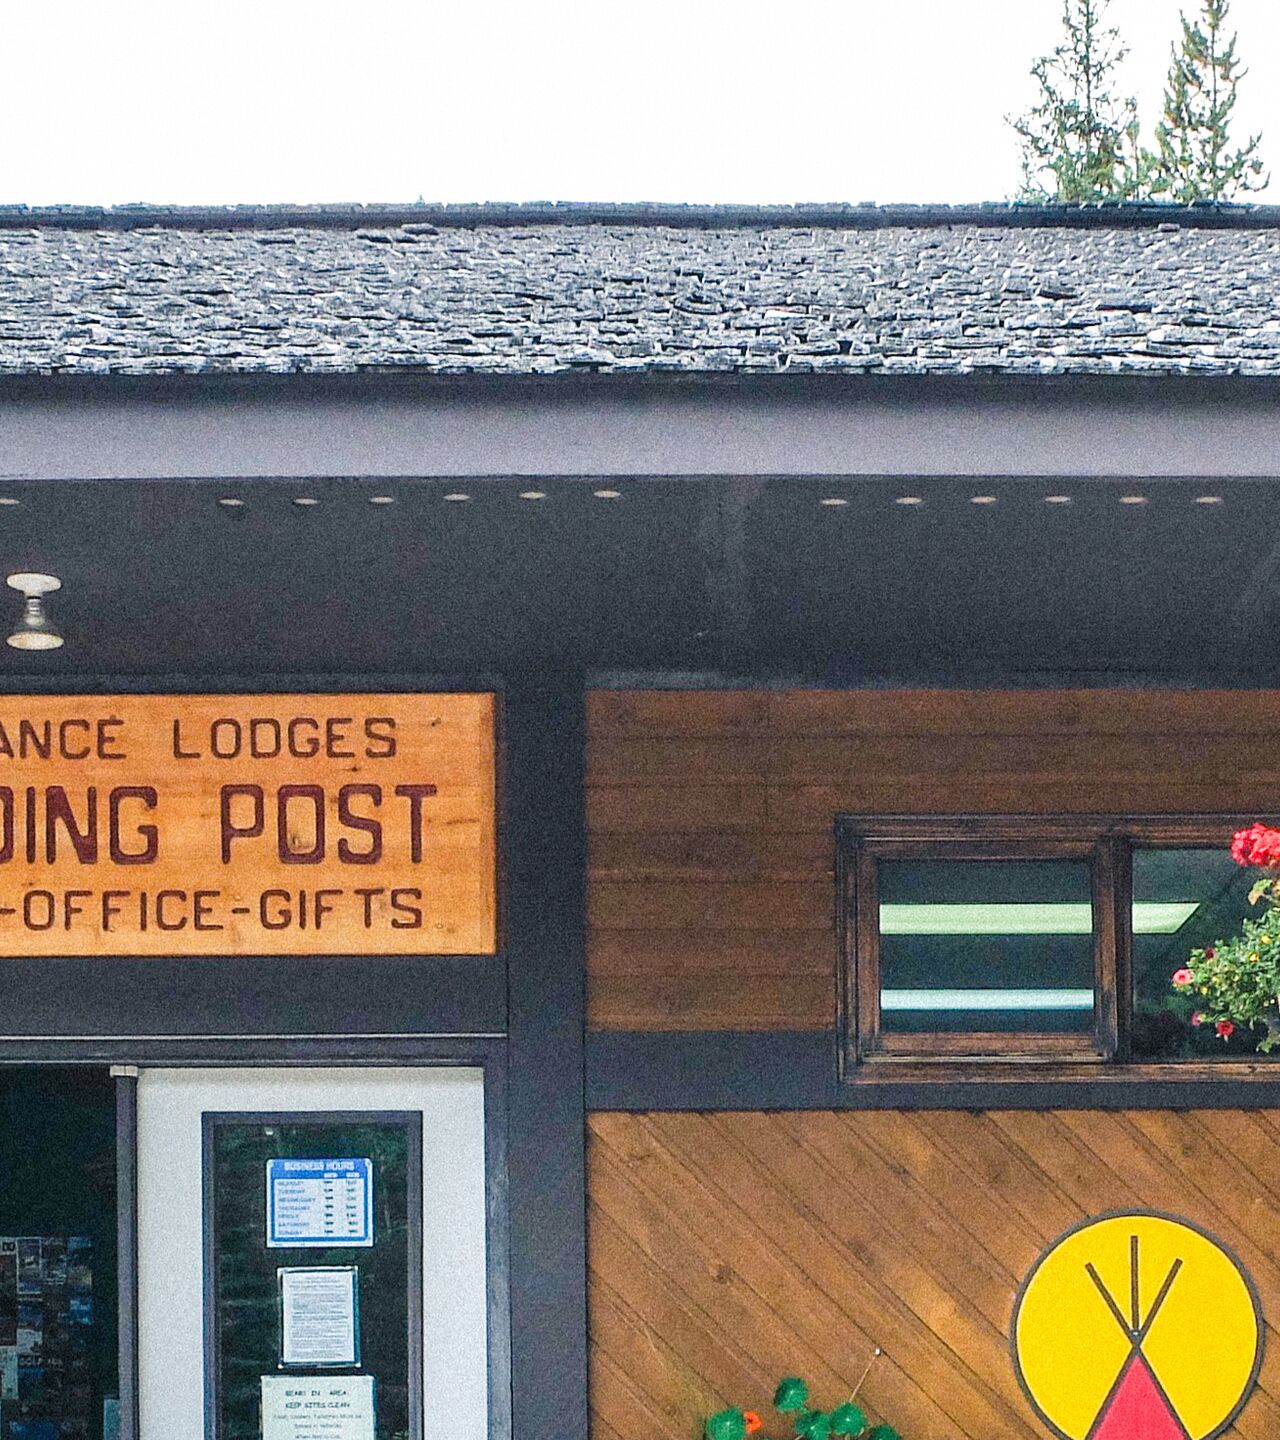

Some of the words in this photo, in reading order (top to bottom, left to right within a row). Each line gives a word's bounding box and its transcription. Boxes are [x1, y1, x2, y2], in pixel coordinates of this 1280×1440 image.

[173, 718, 397, 759] LODGES
[220, 784, 438, 865] POST
[284, 1162, 324, 1170] BUSINESS
[326, 1162, 354, 1170] HOURS
[2, 1241, 16, 1252] DO
